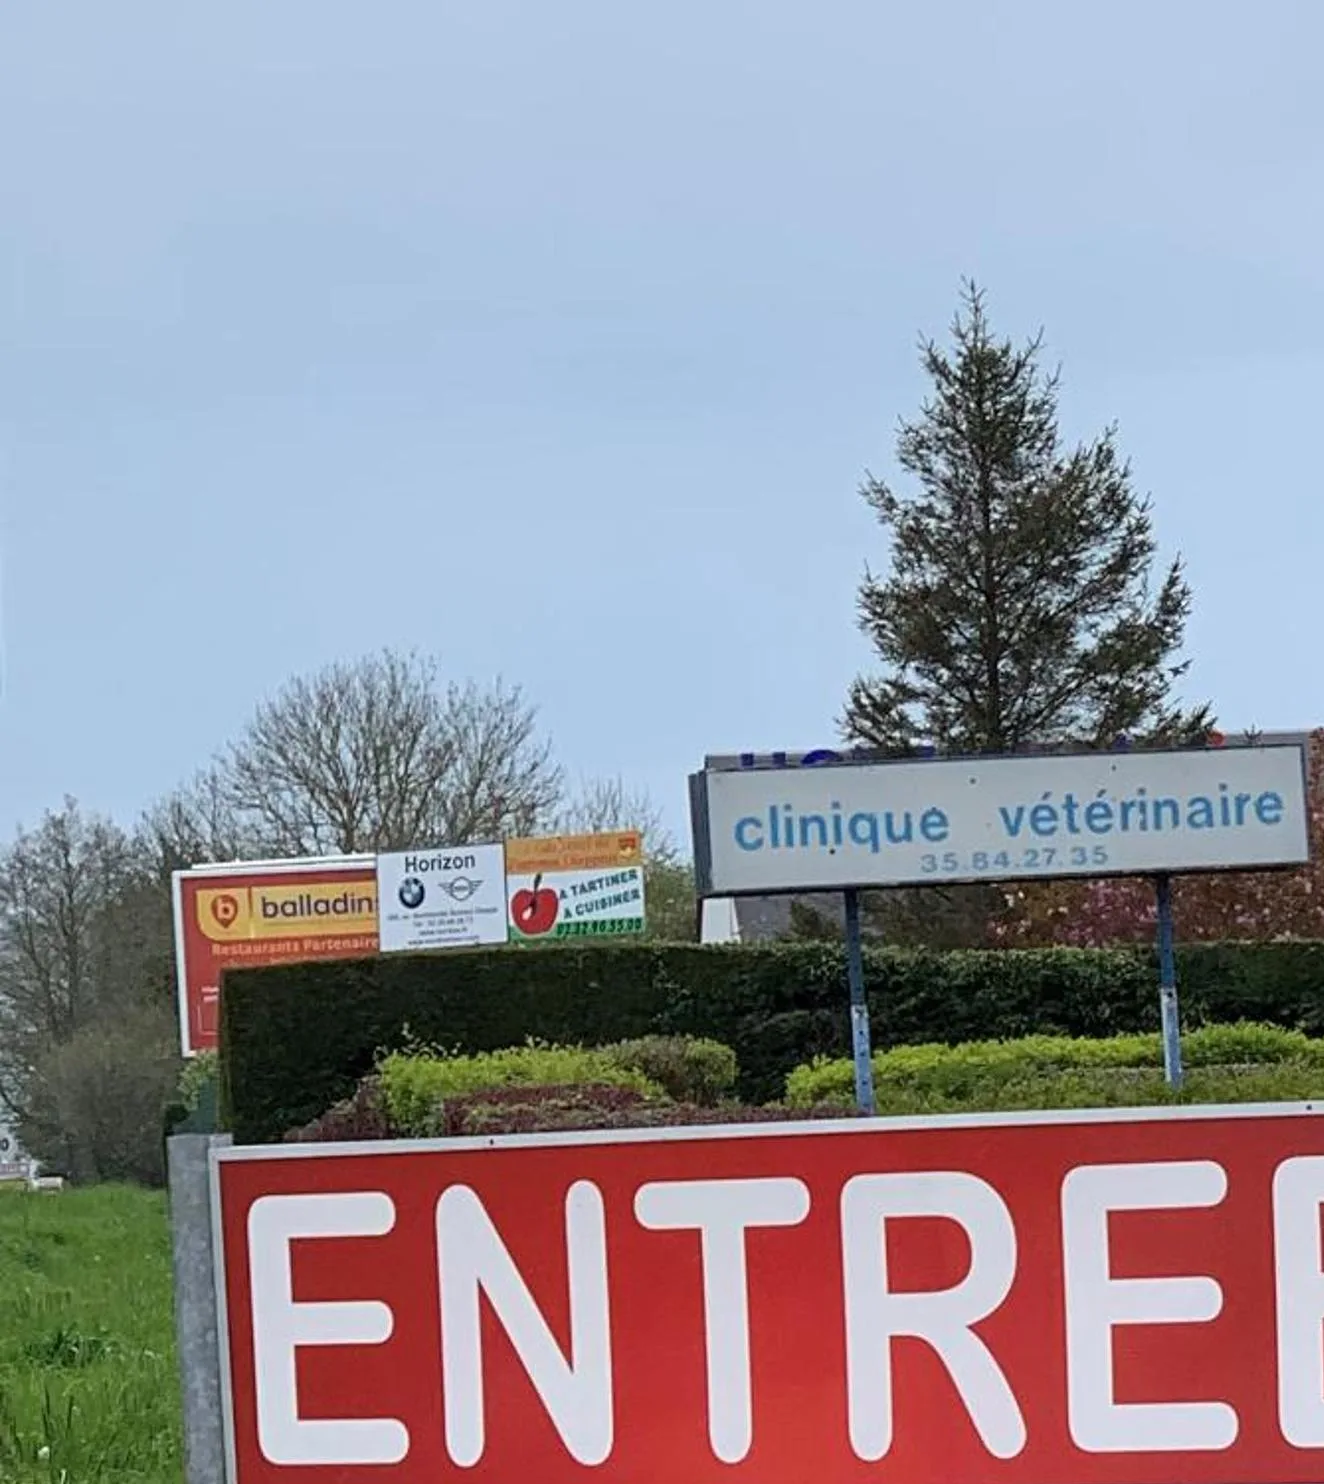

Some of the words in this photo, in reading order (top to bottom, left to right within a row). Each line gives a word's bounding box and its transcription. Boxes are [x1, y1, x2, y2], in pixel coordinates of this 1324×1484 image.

[734, 801, 950, 854] clinique
[1000, 783, 1284, 838] vétérinaire
[405, 854, 476, 873] Horizon
[920, 846, 1109, 874] 35.84.27.35
[570, 868, 639, 897] TARTINER
[262, 892, 378, 918] balladin
[575, 889, 640, 916] CUISINER
[212, 941, 299, 955] Restaurants
